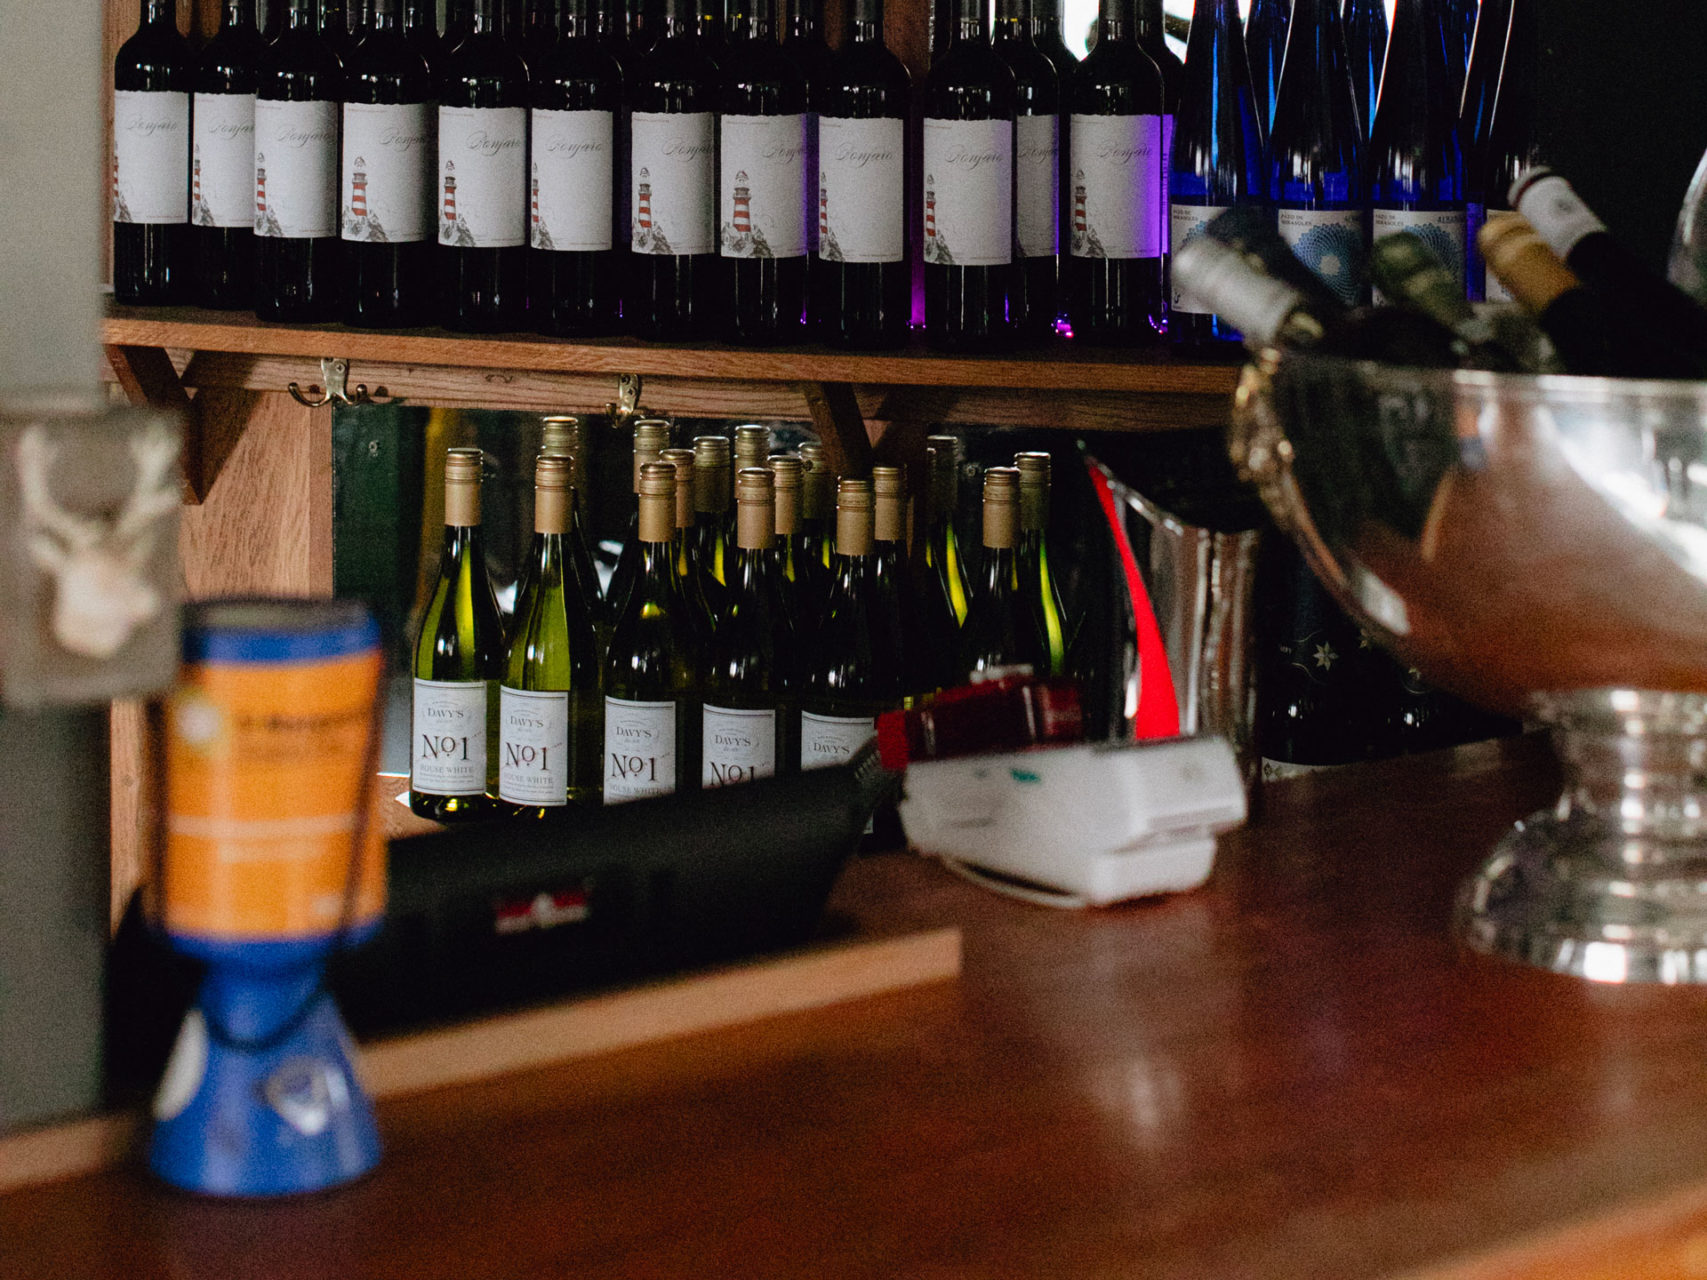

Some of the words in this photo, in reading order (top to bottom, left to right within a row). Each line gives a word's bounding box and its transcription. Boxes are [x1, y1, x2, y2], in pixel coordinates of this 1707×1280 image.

[428, 708, 464, 718] DAVY'S
[510, 716, 544, 728] DAVY'S
[616, 726, 652, 738] DAVY'S
[715, 735, 751, 747] DAVY'S
[813, 742, 850, 753] DAVY'S
